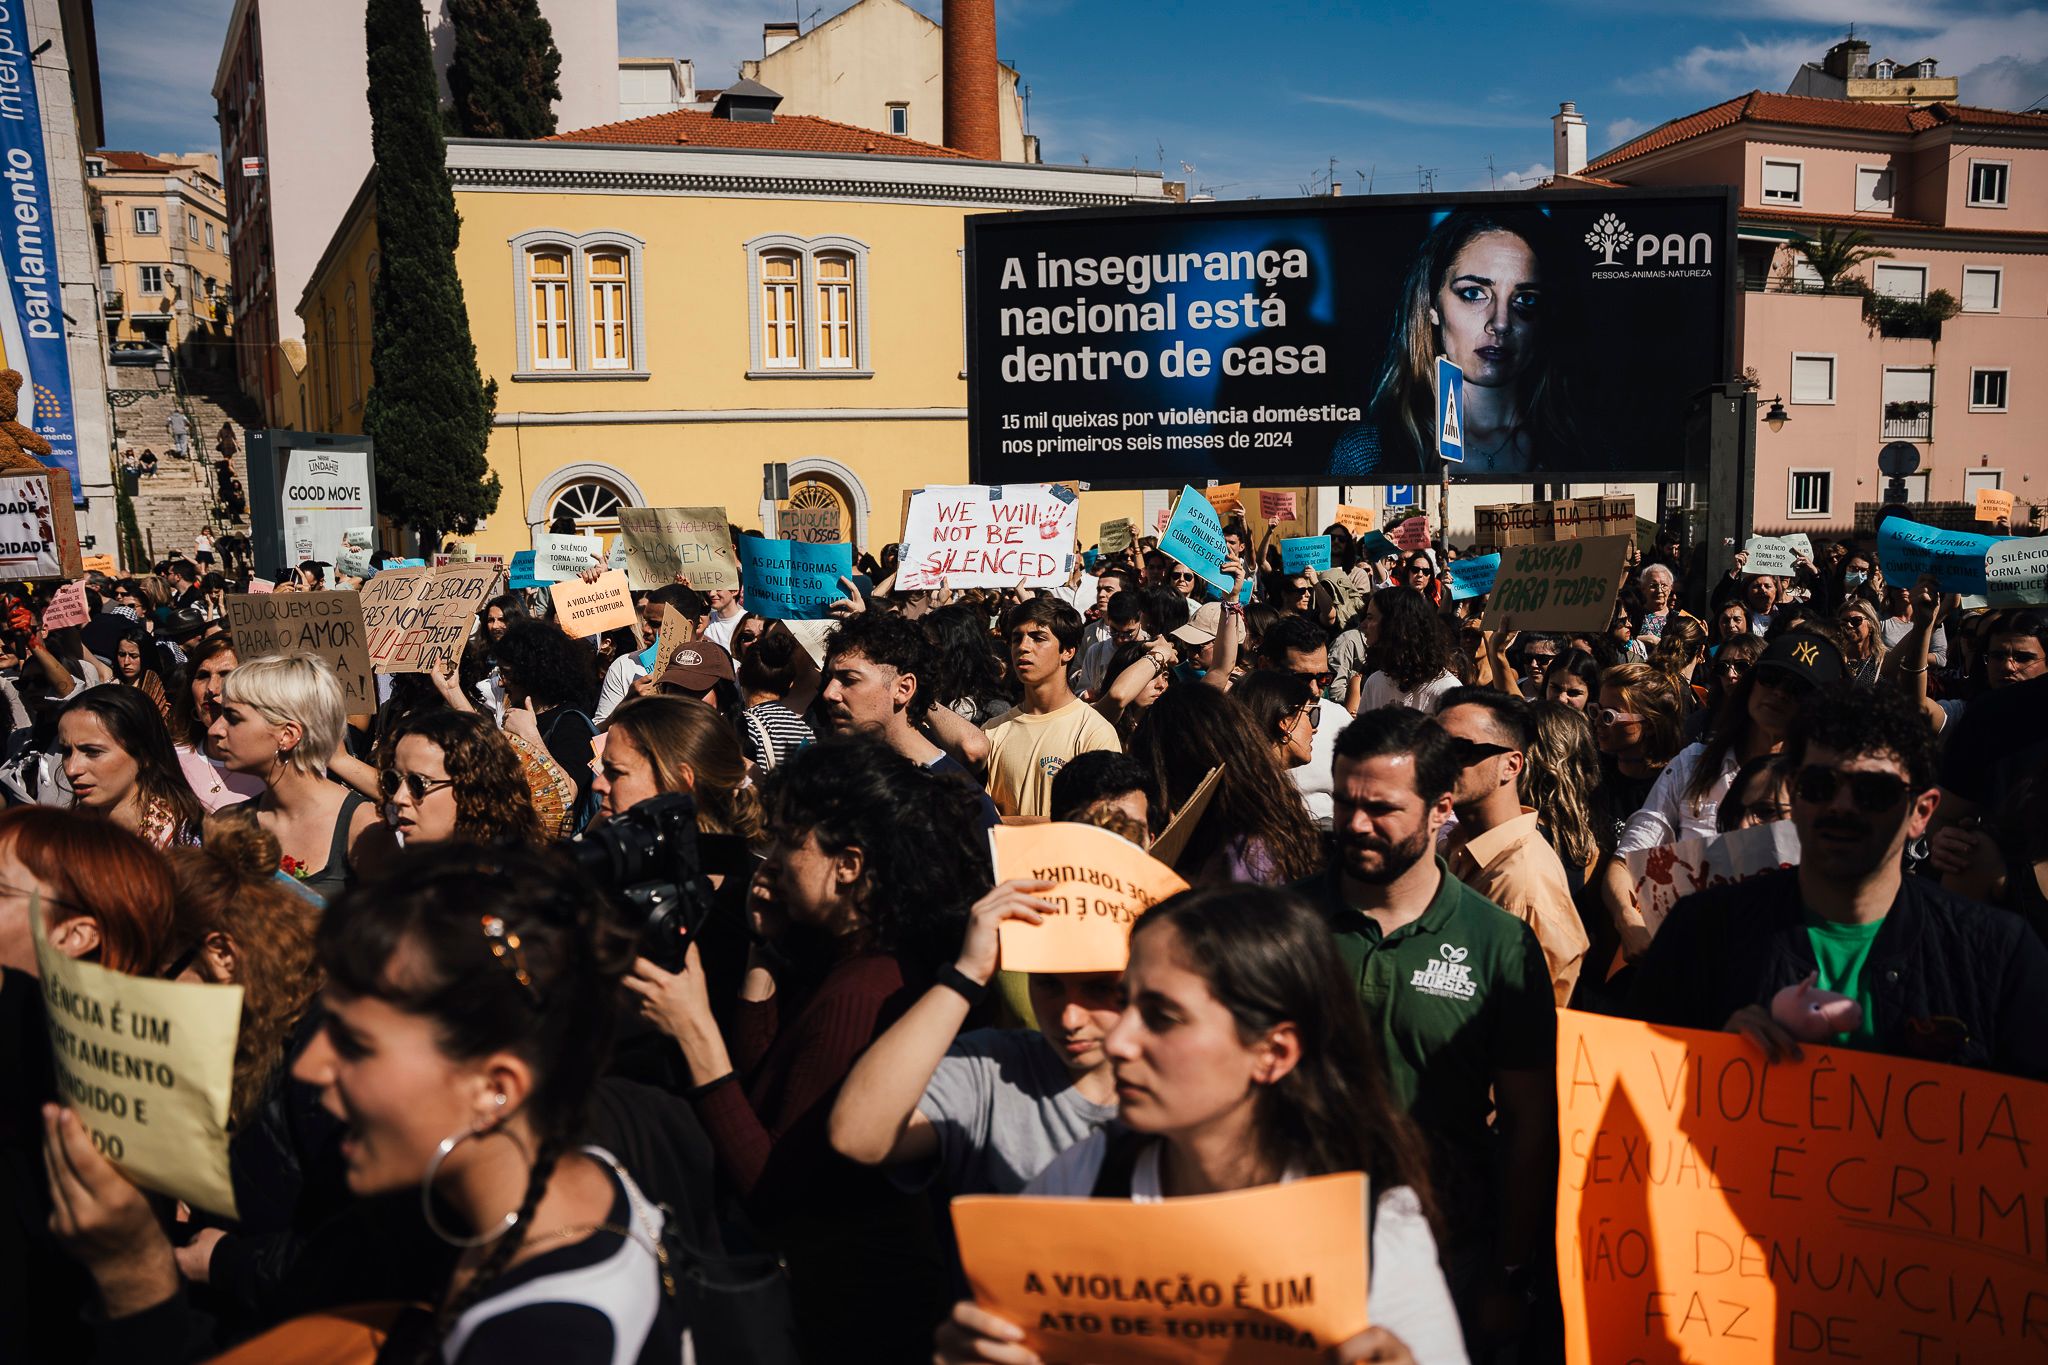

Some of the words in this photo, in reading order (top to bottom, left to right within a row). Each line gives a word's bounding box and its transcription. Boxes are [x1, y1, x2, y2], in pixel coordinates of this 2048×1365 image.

[4, 148, 60, 339] parlamento
[1636, 232, 1712, 265] PAN
[1000, 257, 1026, 290] A
[1038, 248, 1308, 295] insegurança
[1001, 294, 1176, 337] nacional
[1188, 293, 1286, 330] está
[1002, 346, 1149, 382] dentro
[1160, 341, 1211, 378] de
[1222, 342, 1326, 377] casa
[1001, 414, 1020, 430] 15
[1024, 411, 1048, 429] mil
[1052, 410, 1119, 433] queixas
[1122, 411, 1154, 431] por
[1158, 406, 1248, 425] violência
[1252, 404, 1361, 423] doméstica
[1002, 439, 1033, 454] nos
[1036, 434, 1123, 457] primeiros
[1126, 433, 1163, 450] seis
[1166, 434, 1224, 450] meses
[1228, 430, 1250, 448] de
[1254, 431, 1293, 448] 2024
[288, 485, 326, 501] GOOD
[328, 486, 361, 501] MOVE
[1392, 485, 1409, 503] P
[781, 510, 839, 528] EDUQUEM
[937, 501, 976, 523] WE
[1187, 506, 1198, 518] AS
[1479, 508, 1540, 533] PROTEGE
[1556, 506, 1580, 527] TUA
[1588, 502, 1628, 524] FILHA
[551, 543, 557, 551] O
[560, 542, 588, 552] SILÊNCIO
[780, 528, 799, 542] OS
[803, 527, 840, 543] VOSSOS
[933, 525, 977, 543] NOT
[986, 525, 1024, 544] BE
[1171, 528, 1206, 557] CÚMPLICES
[1204, 551, 1216, 563] DE
[1191, 524, 1216, 547] ONLINE
[1215, 541, 1227, 555] SÃO
[1764, 542, 1786, 552] SILÊNCIO
[1890, 531, 1903, 541] AS
[1903, 533, 1978, 548] PLATAFORMAS
[550, 554, 571, 562] TORNA
[641, 541, 713, 565] HOMEM
[752, 557, 764, 568] AS
[766, 558, 838, 574] PLATAFORMAS
[1755, 552, 1772, 560] TORNA
[1756, 560, 1783, 568] CÚMPLICES
[1934, 549, 1956, 561] SÃO
[1986, 556, 1994, 565] O
[2001, 550, 2048, 563] SILÊNCIO
[551, 564, 586, 572] CÚMPLICES
[364, 577, 420, 603] ANTES
[747, 584, 797, 605] CÚMPLICES
[799, 595, 812, 606] DE
[765, 574, 800, 589] ONLINE
[802, 576, 823, 590] SÃO
[1492, 576, 1550, 613] PARA
[566, 600, 573, 609] A
[572, 592, 605, 608] VIOLAÇÃO
[605, 591, 610, 600] É
[610, 588, 621, 598] UM
[571, 610, 585, 621] ATO
[586, 607, 596, 616] DE
[596, 600, 625, 614] TORTURA
[231, 598, 344, 627] EDUQUEMOS
[237, 629, 274, 655] PARA
[278, 629, 292, 648] O
[297, 620, 360, 649] AMOR
[1791, 641, 1820, 667] NY
[1033, 865, 1125, 895] TORTURA
[1425, 958, 1473, 981] DARK
[49, 974, 105, 1029] ÊNCIA
[110, 997, 123, 1035] É
[130, 1011, 171, 1046] UM
[133, 1097, 149, 1125] E
[1568, 1032, 1603, 1111] A
[1650, 1046, 2033, 1169] VIOLÊNCIA
[1569, 1128, 1742, 1194] SEXUAL
[1769, 1137, 1807, 1201] É
[1572, 1215, 1650, 1284] NÃO
[1023, 1270, 1047, 1297] A
[1051, 1271, 1222, 1311] VIOLAÇÃO
[1233, 1273, 1252, 1309] É
[1260, 1274, 1316, 1311] UM
[1038, 1310, 1101, 1335] ATO
[1109, 1313, 1147, 1337] DE
[1162, 1317, 1318, 1351] TORTURA
[1643, 1290, 1759, 1342] FAZ
[1788, 1310, 1863, 1360] DE
